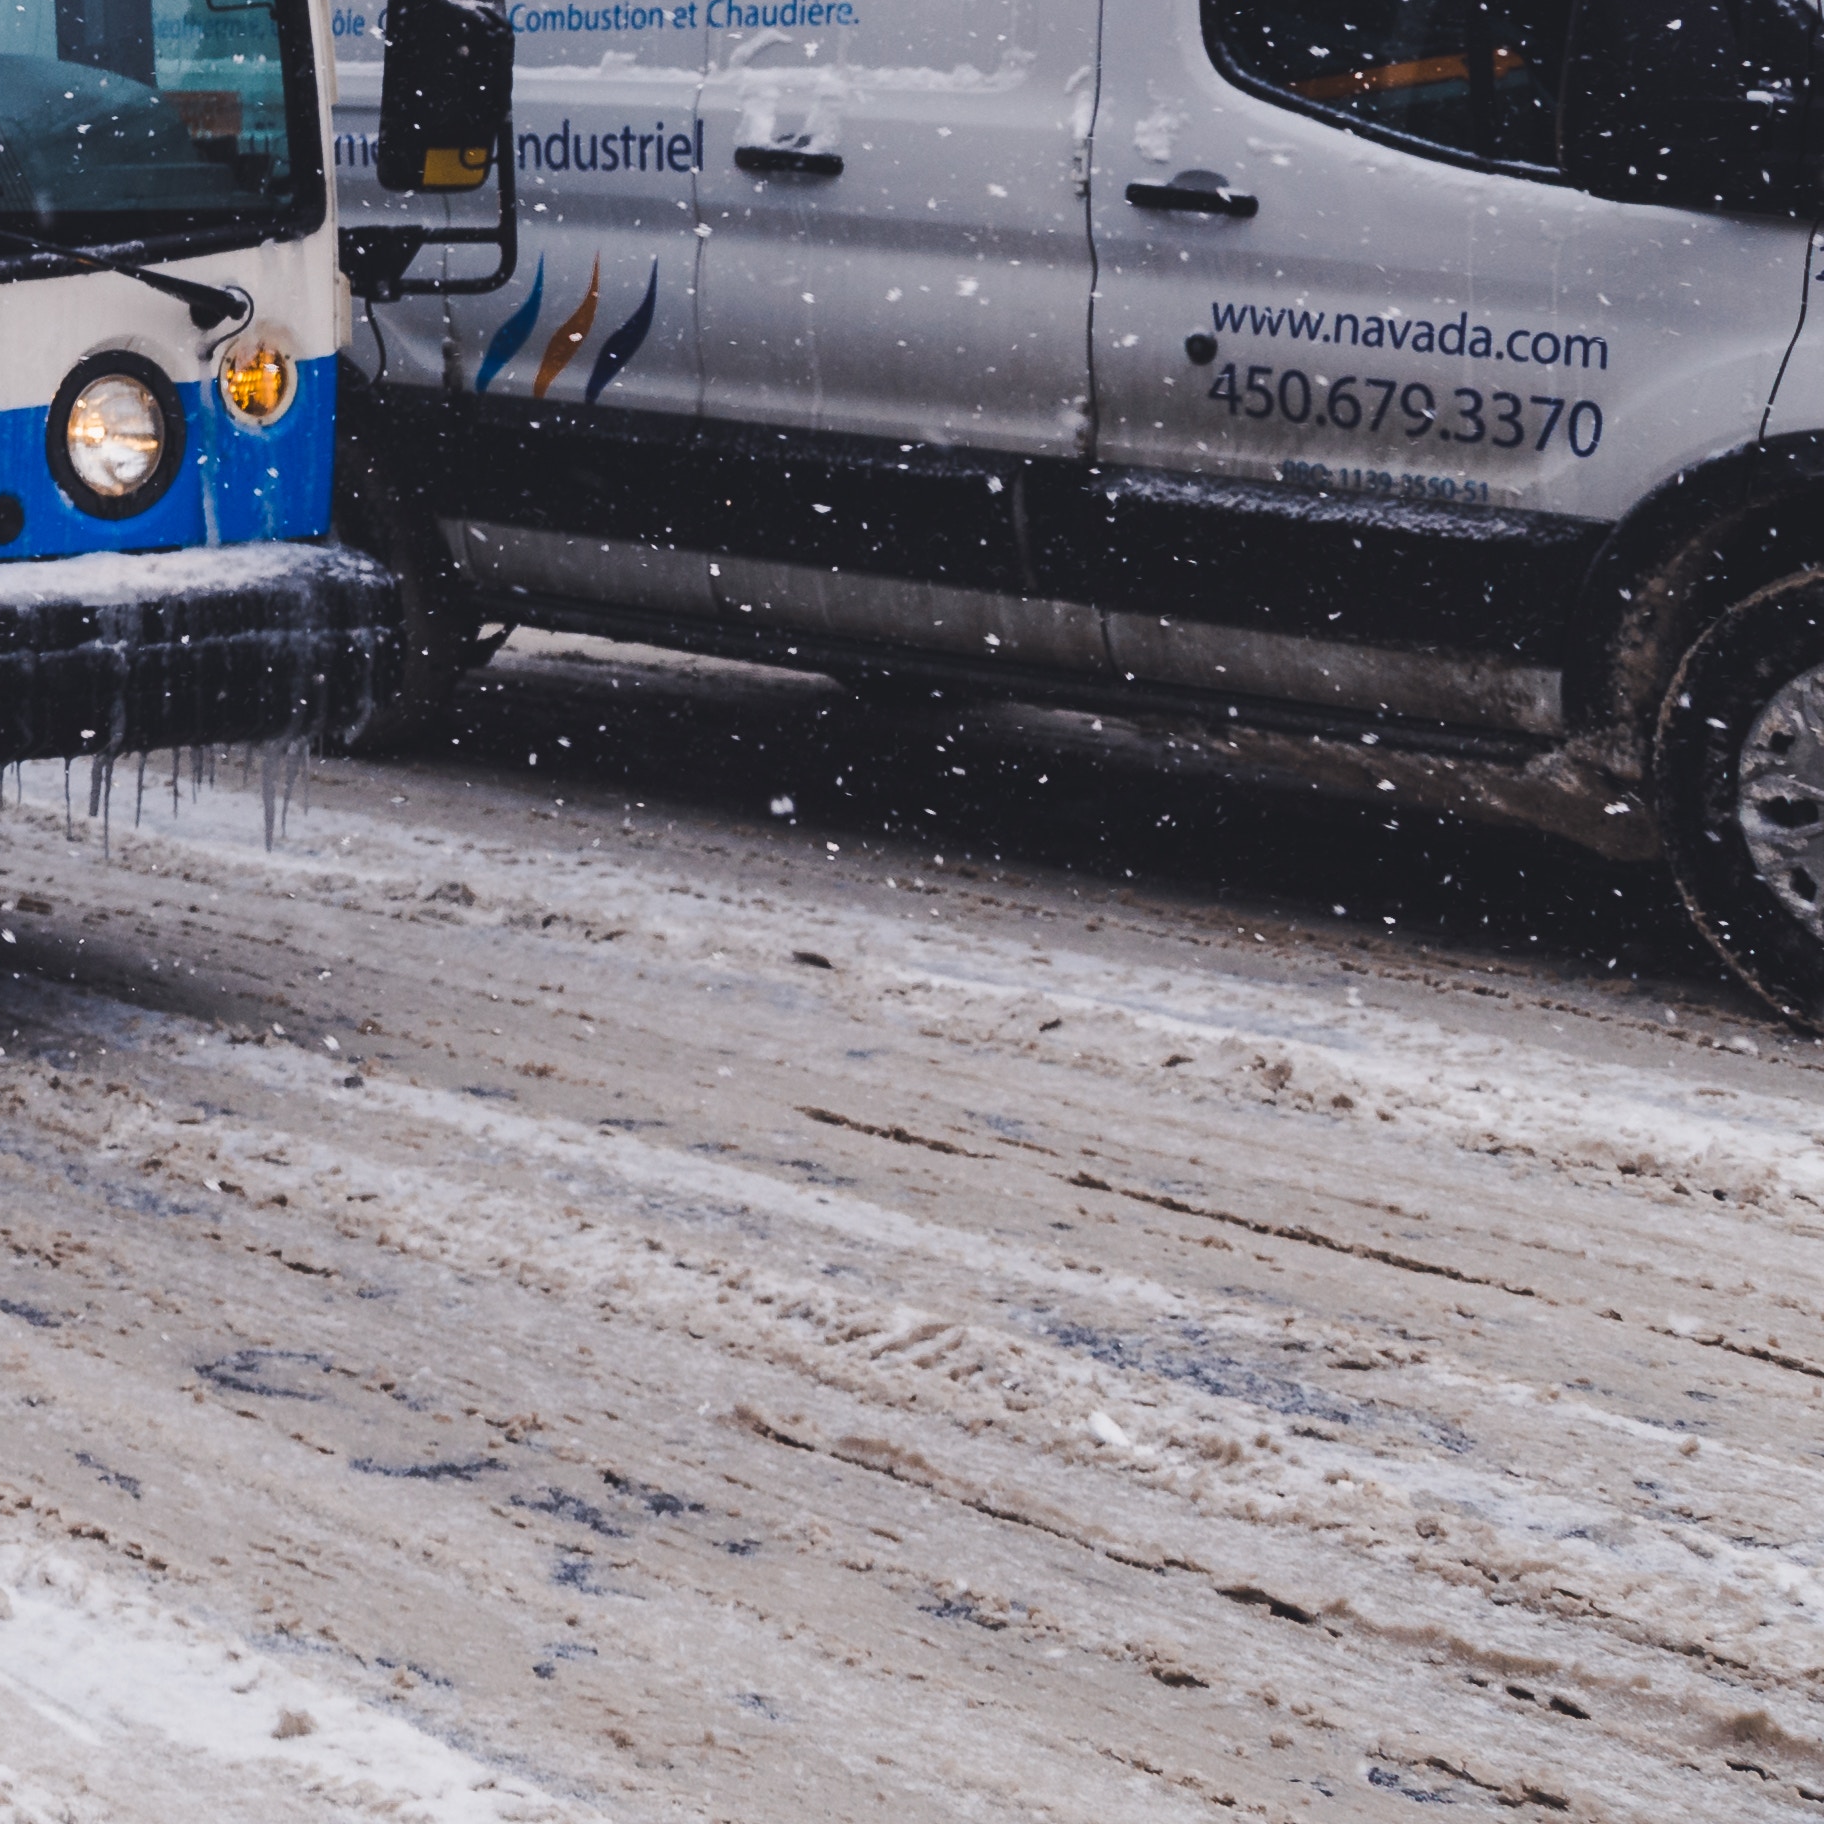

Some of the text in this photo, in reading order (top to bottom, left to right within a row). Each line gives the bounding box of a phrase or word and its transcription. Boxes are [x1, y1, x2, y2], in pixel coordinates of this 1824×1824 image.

[508, 1, 664, 33] Combustion
[672, 1, 698, 28] et
[518, 118, 705, 172] ndustriel
[1211, 301, 1609, 370] www.navada.com
[1208, 363, 1604, 458] 450.679.3370
